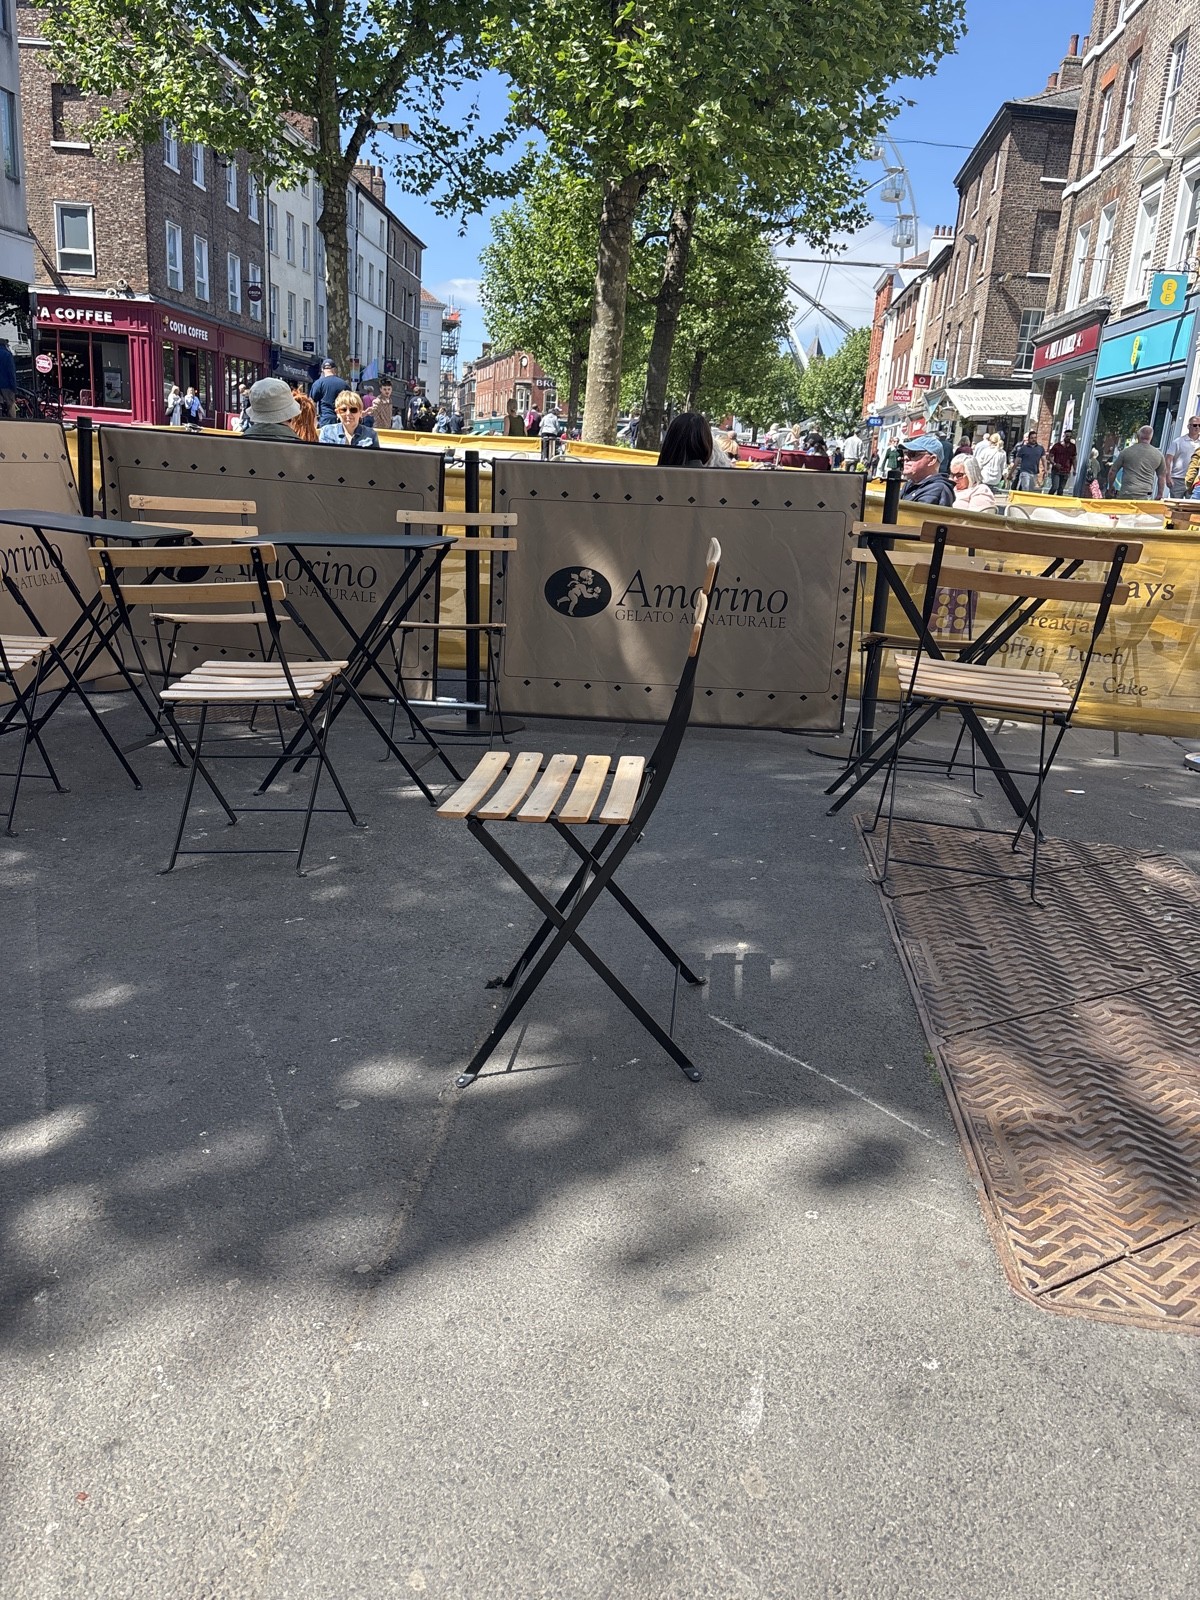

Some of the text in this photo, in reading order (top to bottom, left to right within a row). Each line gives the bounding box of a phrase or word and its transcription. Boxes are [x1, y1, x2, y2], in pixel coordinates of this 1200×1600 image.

[55, 307, 113, 323] COFFEE
[169, 320, 209, 341] COSTA COFFEE
[959, 394, 1014, 402] Shambles
[964, 403, 1006, 412] Market
[15, 571, 64, 590] ATURAL
[615, 609, 787, 629] GELATO AL NATURALE
[995, 636, 1124, 665] offee Lunch
[1058, 672, 1149, 697] ea Cake
